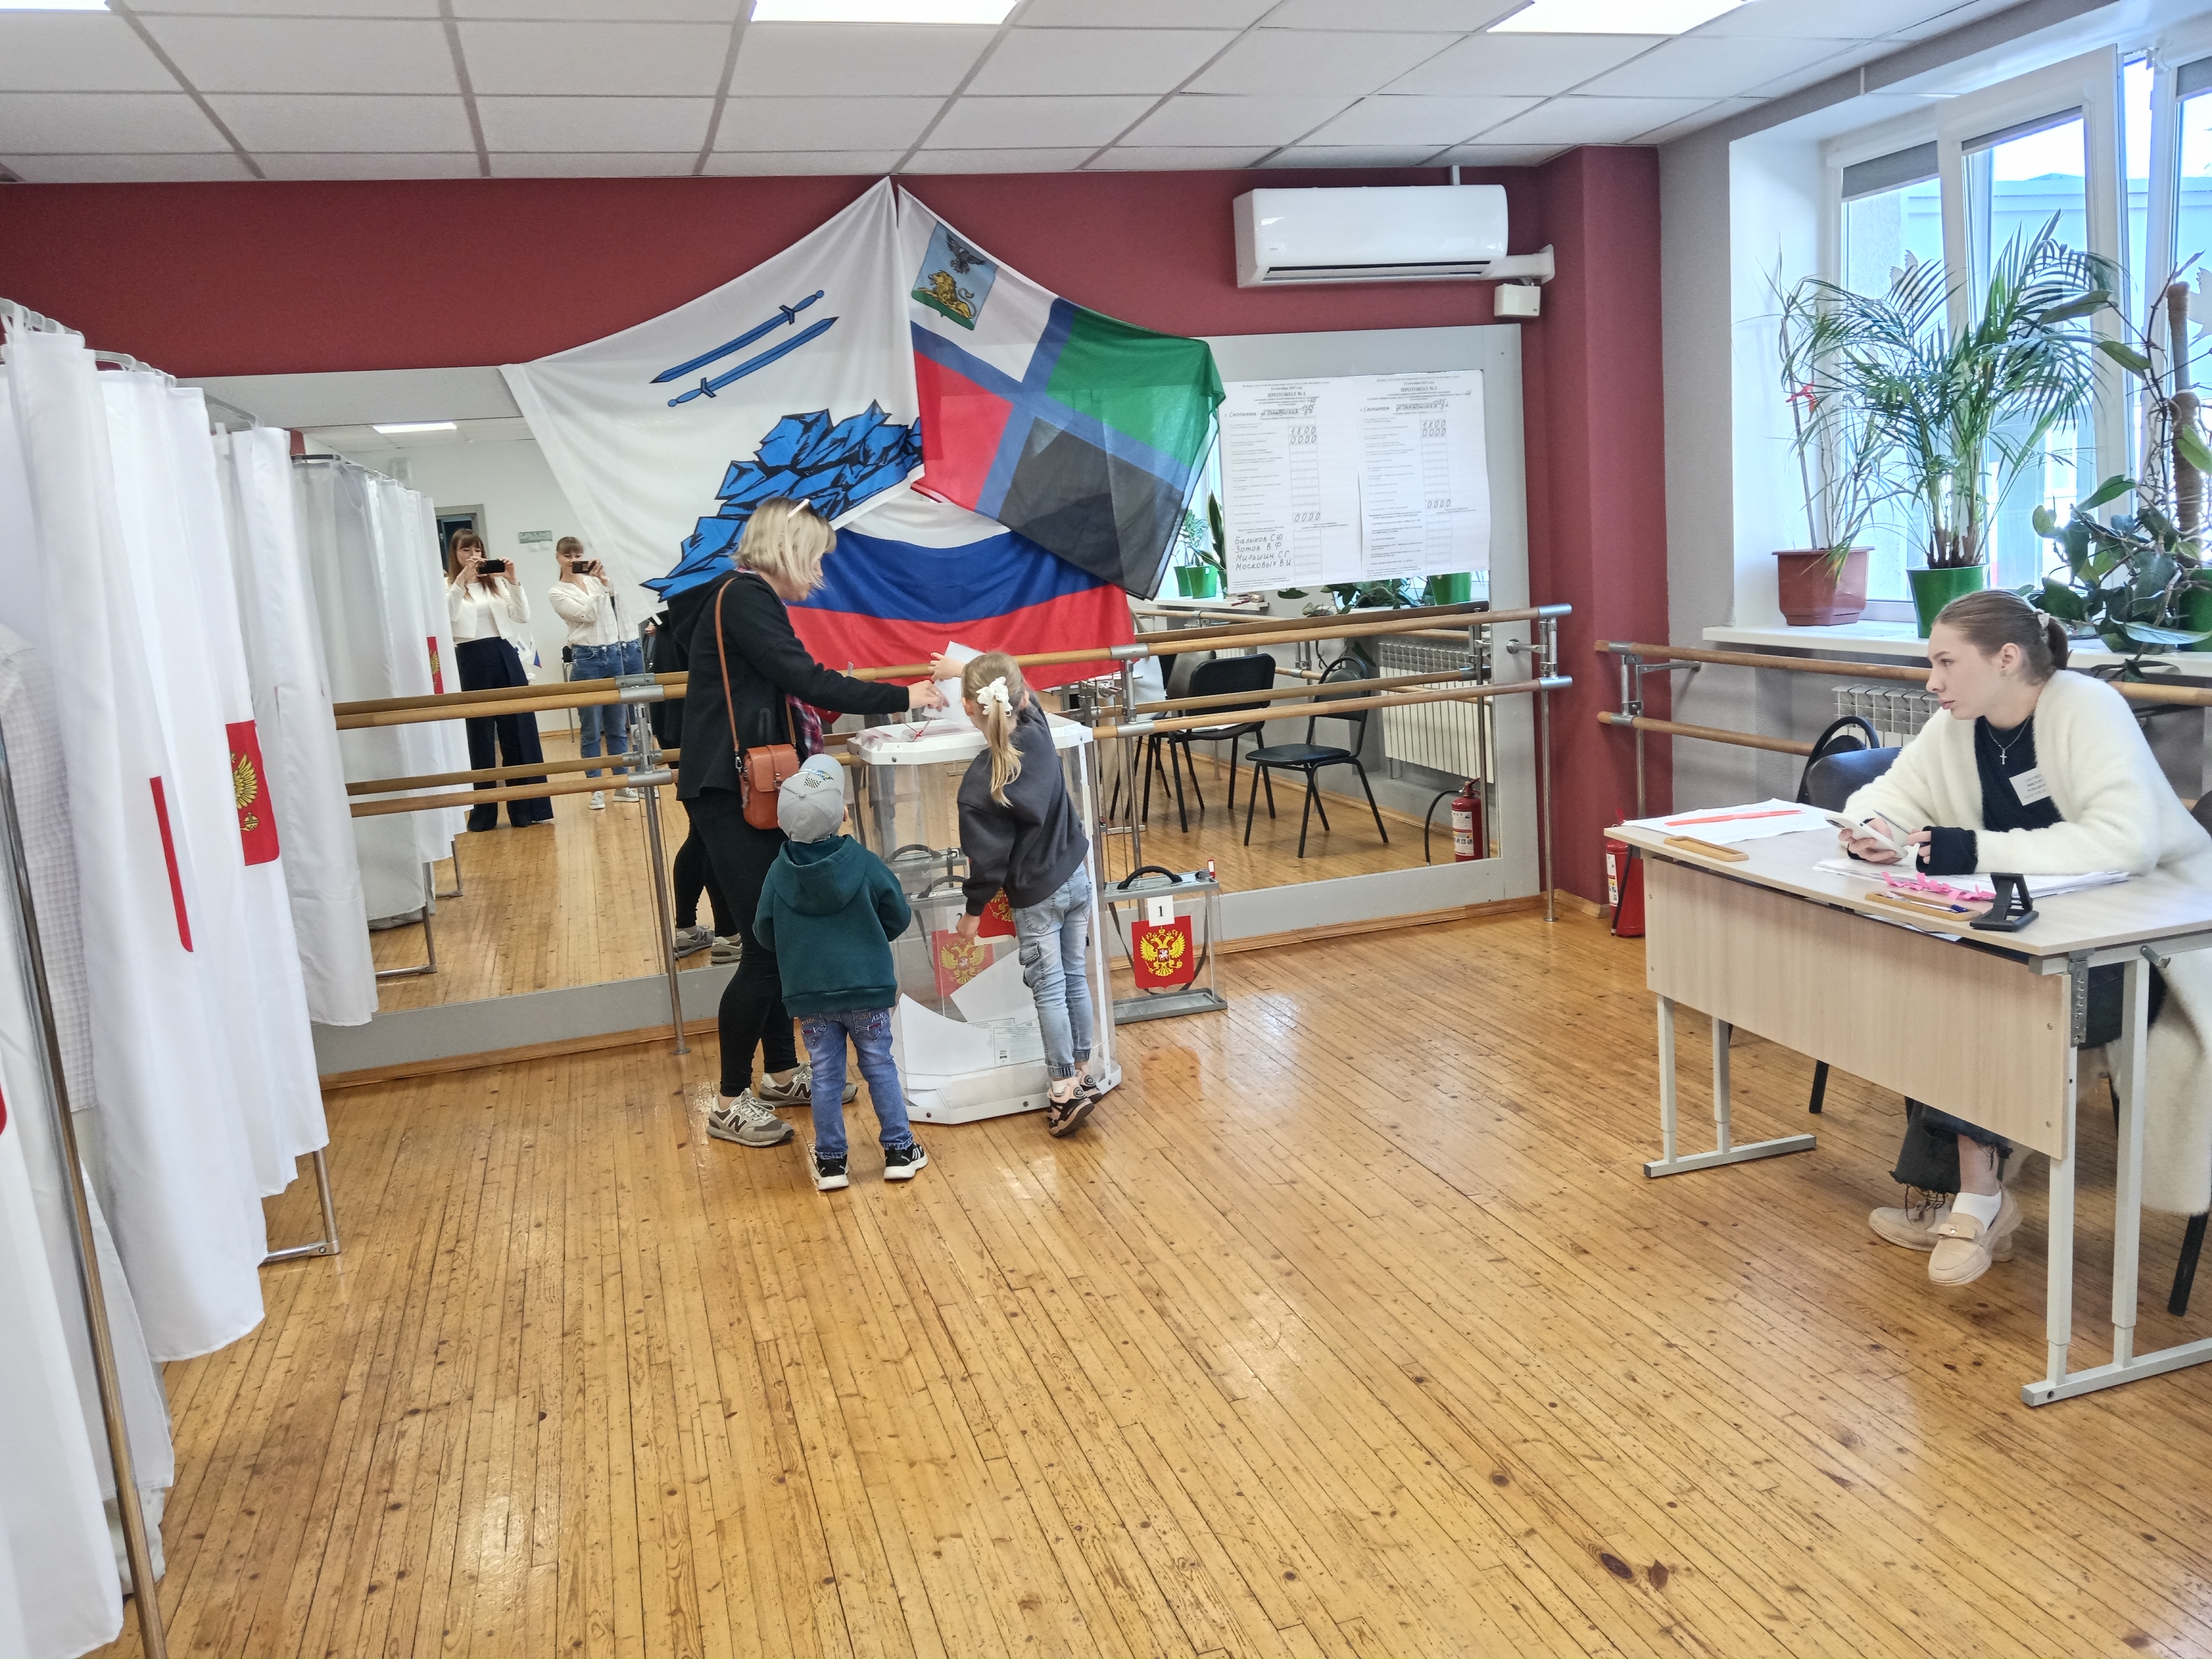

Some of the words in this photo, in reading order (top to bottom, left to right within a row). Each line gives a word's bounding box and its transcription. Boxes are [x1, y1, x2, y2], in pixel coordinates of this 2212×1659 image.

[1423, 420, 1446, 428] 1800
[1291, 427, 1316, 435] 1800
[1422, 428, 1446, 437] 0000
[1290, 435, 1317, 444] 0000
[1428, 500, 1450, 508] 0000
[1295, 513, 1320, 522] 0000
[1235, 536, 1267, 545] Балыков
[1235, 545, 1260, 553] Зотов
[1236, 553, 1274, 561] Мильшин
[1236, 561, 1277, 571] Московых
[1158, 905, 1164, 917] 1
